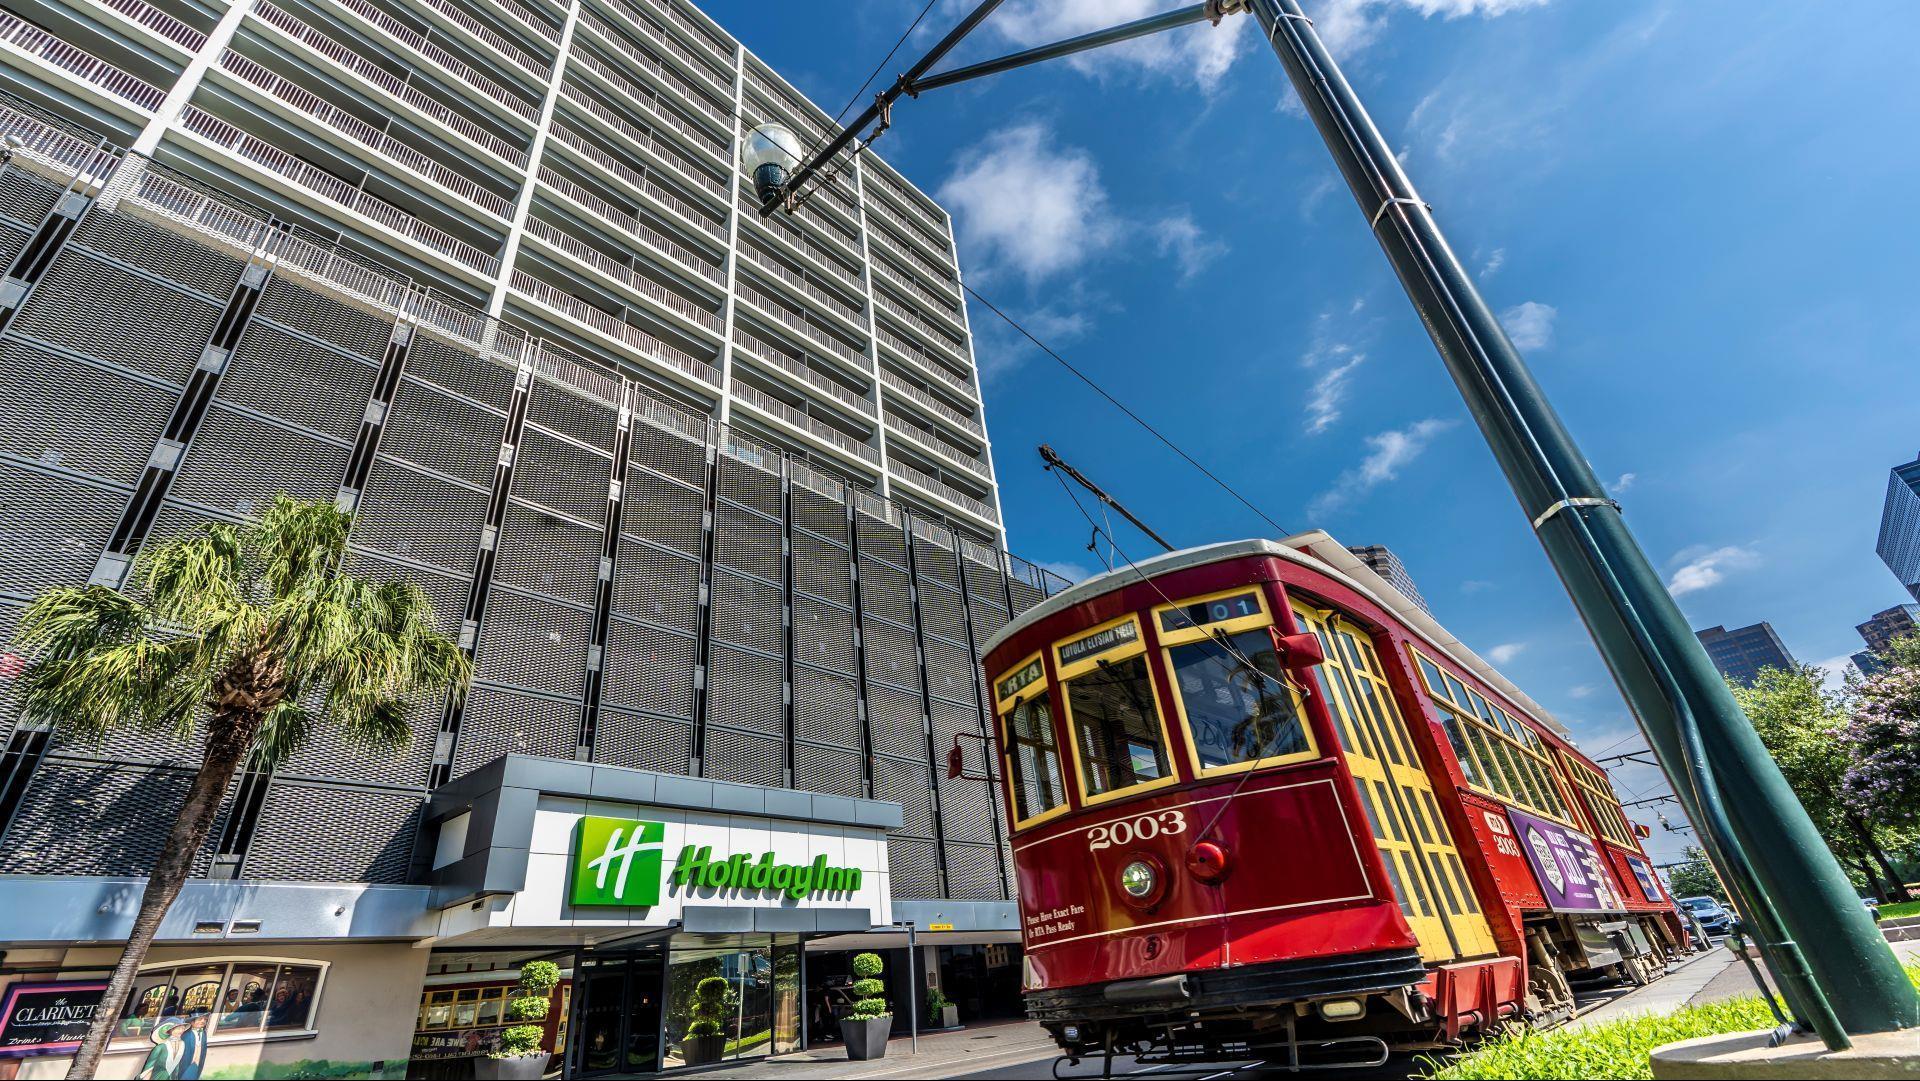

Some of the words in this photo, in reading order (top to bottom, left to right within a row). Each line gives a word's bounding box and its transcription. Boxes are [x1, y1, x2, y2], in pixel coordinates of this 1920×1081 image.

[1087, 629, 1114, 650] ELYSIAN
[1007, 663, 1040, 695] RTA
[1087, 810, 1187, 852] 2003
[1493, 834, 1520, 857] 2003
[1040, 912, 1053, 922] Have
[1053, 908, 1070, 919] Exact
[1070, 904, 1085, 915] Fare
[1034, 926, 1046, 937] RTA
[1045, 924, 1057, 935] Pass
[1057, 920, 1076, 931] Ready
[55, 997, 68, 1006] the
[15, 1004, 99, 1022] CLARINET
[7, 1037, 42, 1045] Drinks
